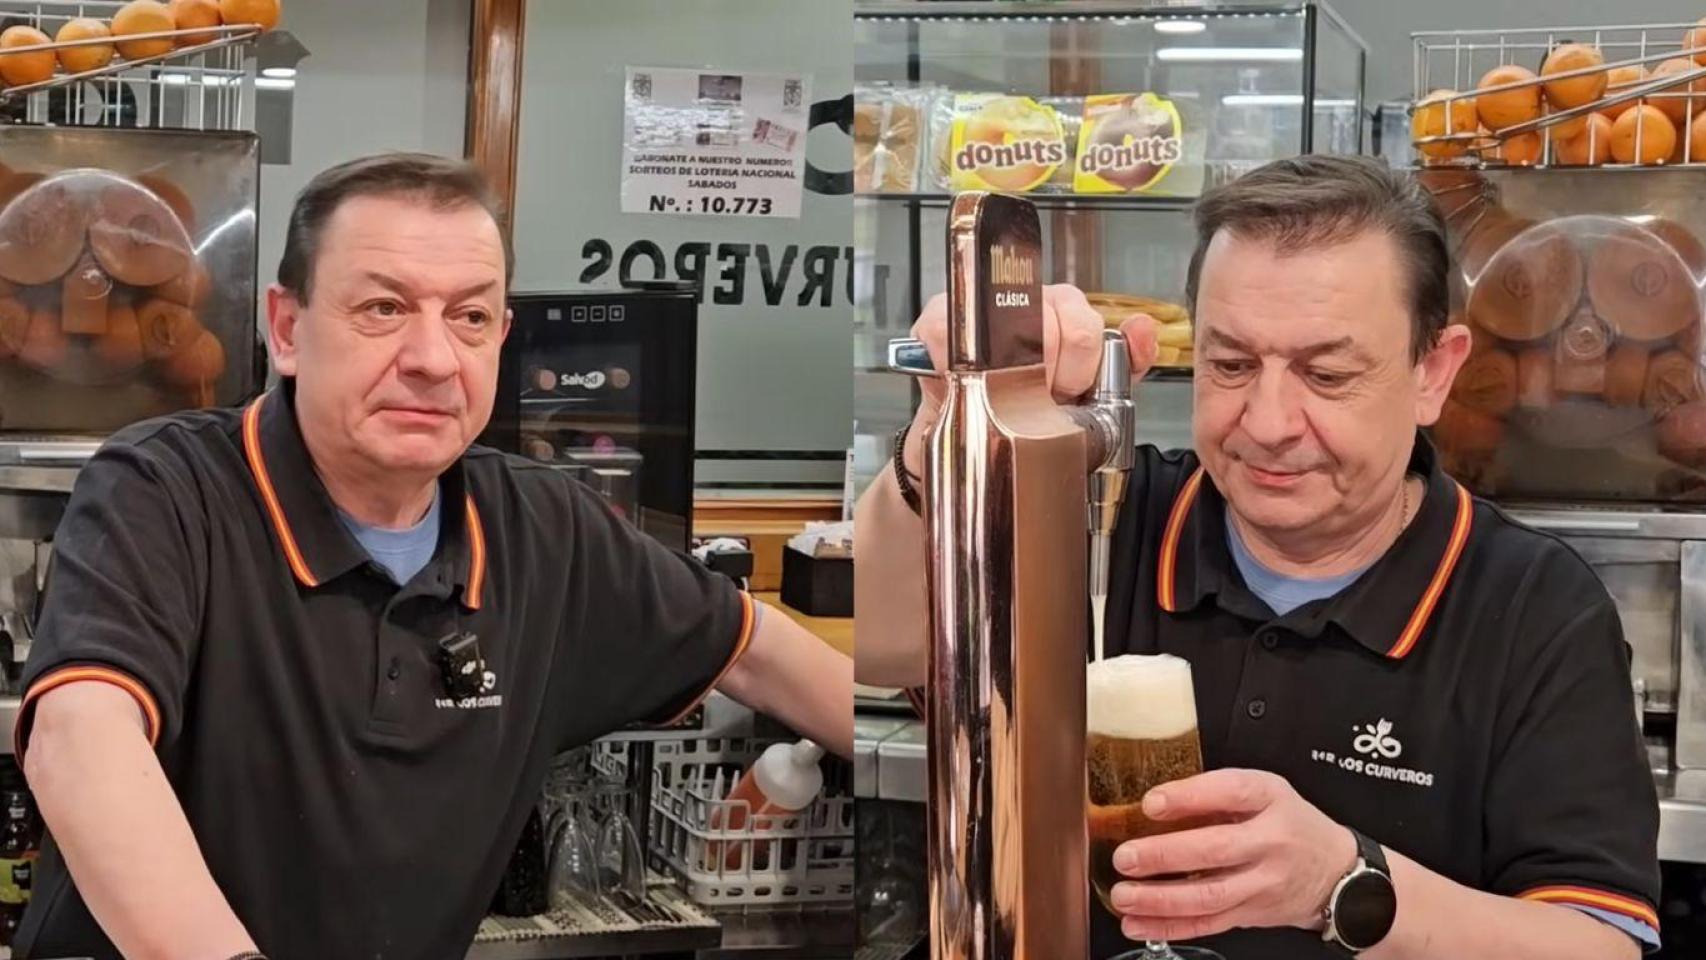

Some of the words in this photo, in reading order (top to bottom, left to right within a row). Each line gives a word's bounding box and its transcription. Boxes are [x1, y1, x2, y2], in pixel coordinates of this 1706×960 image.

[689, 155, 696, 164] A
[698, 155, 742, 165] NUESTRO
[956, 139, 1064, 171] donuts
[1080, 135, 1179, 173] donuts
[629, 165, 676, 176] SORTEOS
[679, 166, 692, 176] DE
[694, 167, 739, 178] LOTERIA
[741, 168, 796, 179] NACIONAL
[688, 179, 737, 190] SABADOS
[701, 196, 772, 215] 10.773
[990, 244, 1034, 285] Mahou
[995, 290, 1030, 307] CLÁSICA
[1365, 763, 1435, 787] CURVEROS
